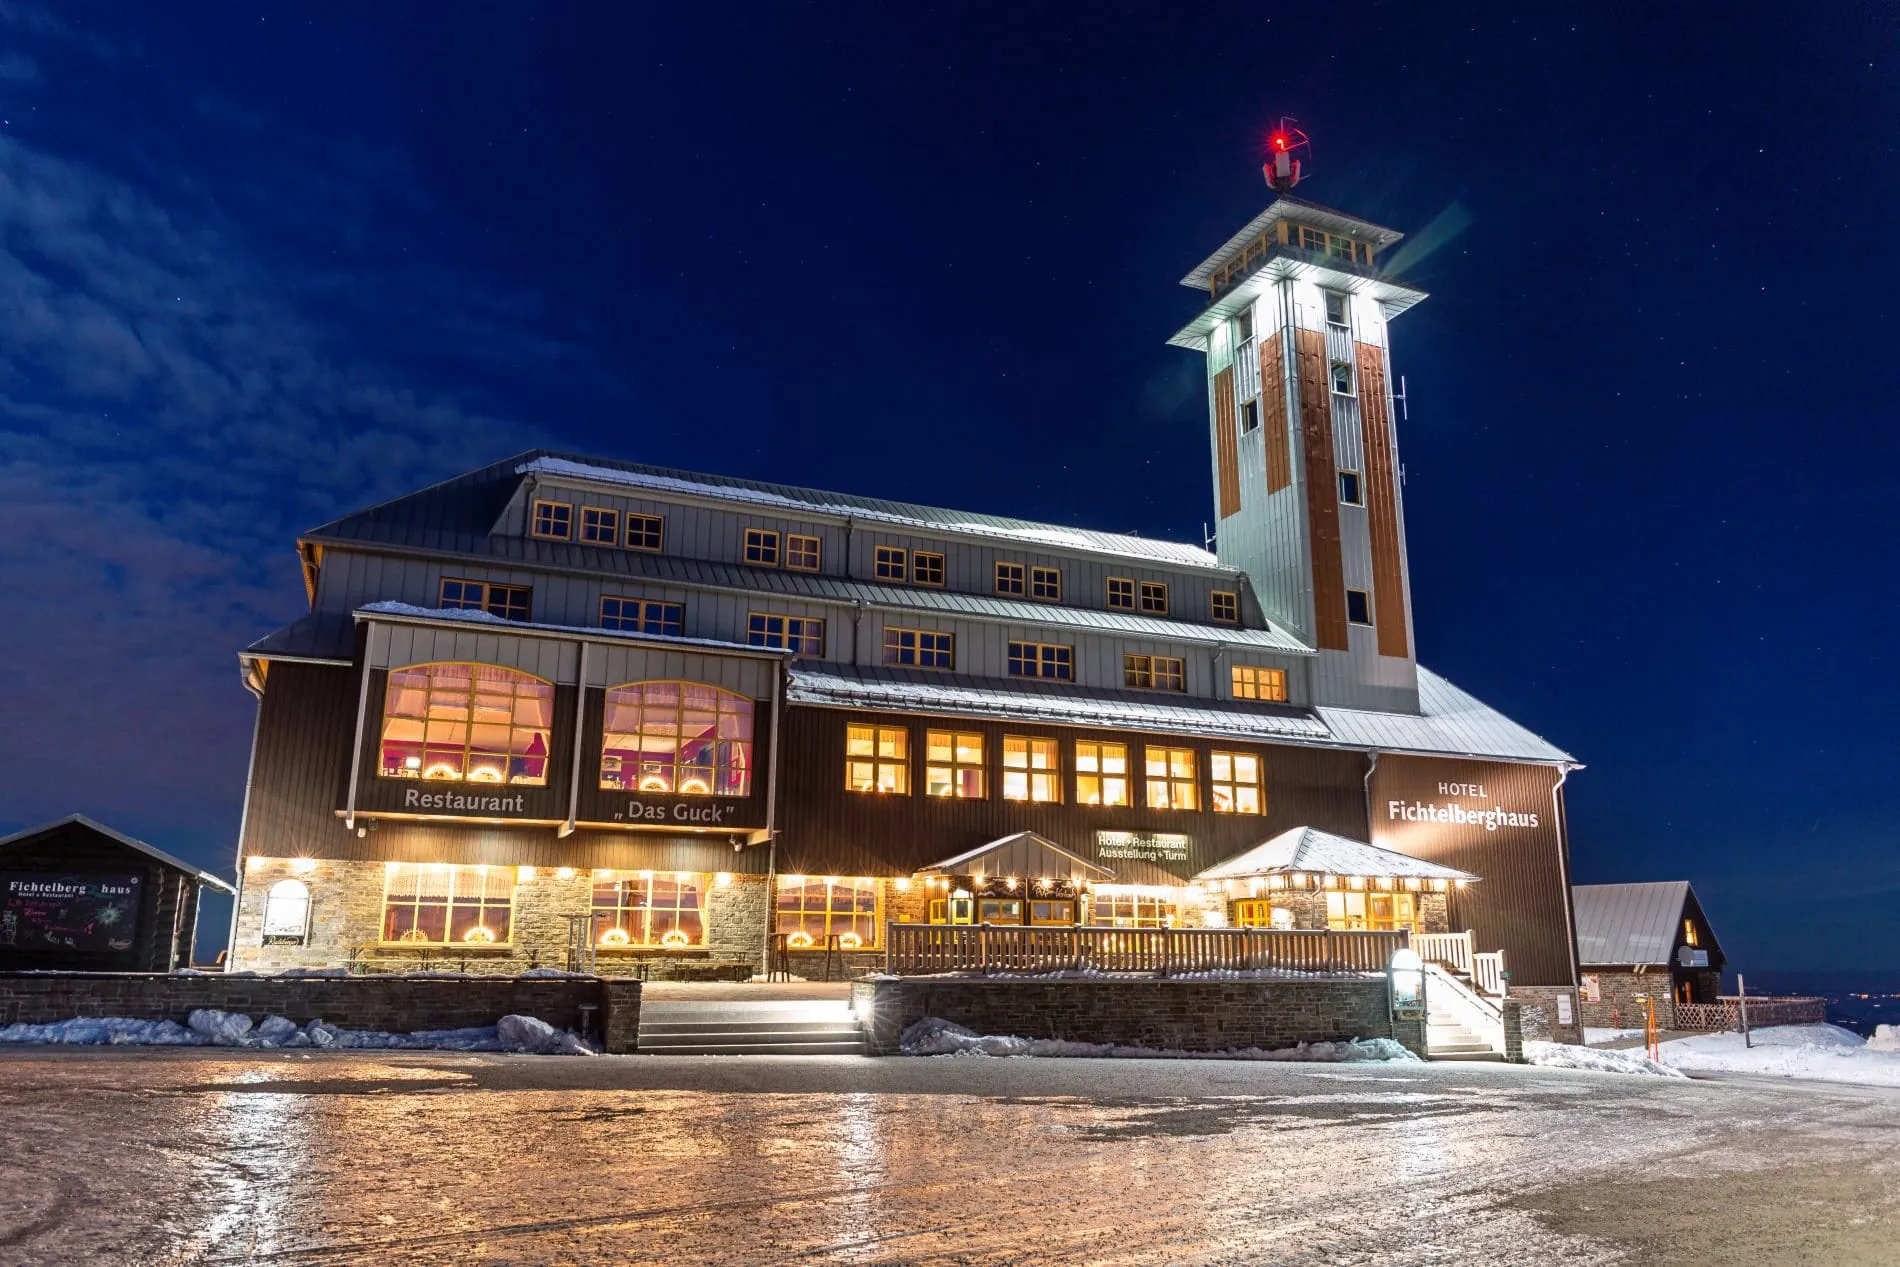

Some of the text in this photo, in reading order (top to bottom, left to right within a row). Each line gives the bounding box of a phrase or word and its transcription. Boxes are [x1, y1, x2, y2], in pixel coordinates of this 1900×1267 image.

[1438, 782, 1488, 798] HOTEL
[404, 788, 524, 812] Restaurant
[1388, 800, 1539, 831] Fichtelberghaus
[1098, 835, 1125, 847] Hotel
[1132, 837, 1186, 849] Restaurant
[1098, 847, 1157, 862] Ausstellung
[1163, 850, 1187, 861] Turm
[9, 881, 131, 895] Fichtelberg haus
